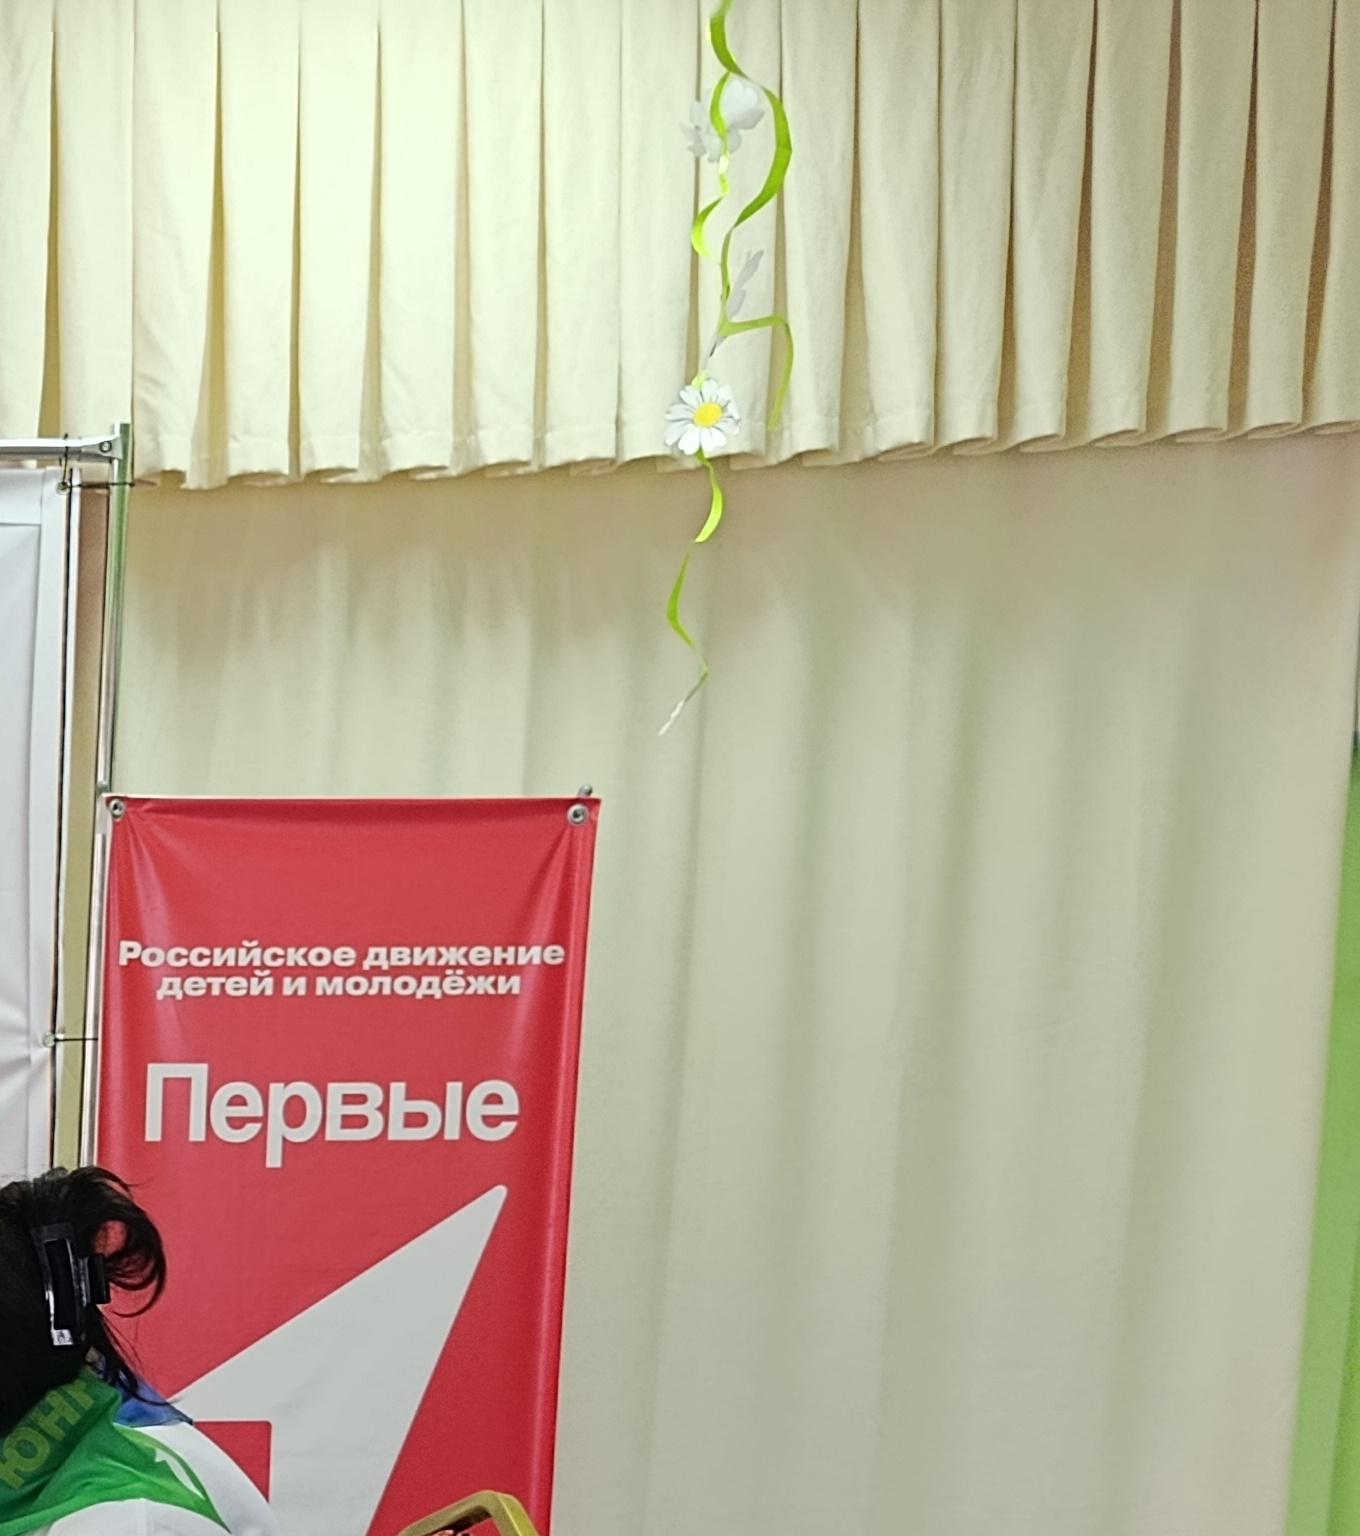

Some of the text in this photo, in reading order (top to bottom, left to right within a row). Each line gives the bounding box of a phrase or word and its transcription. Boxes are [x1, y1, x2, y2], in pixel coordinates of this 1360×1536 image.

[118, 940, 566, 970] Российское движение
[156, 968, 521, 999] детей и молодёжи
[144, 1062, 519, 1168] Первые
